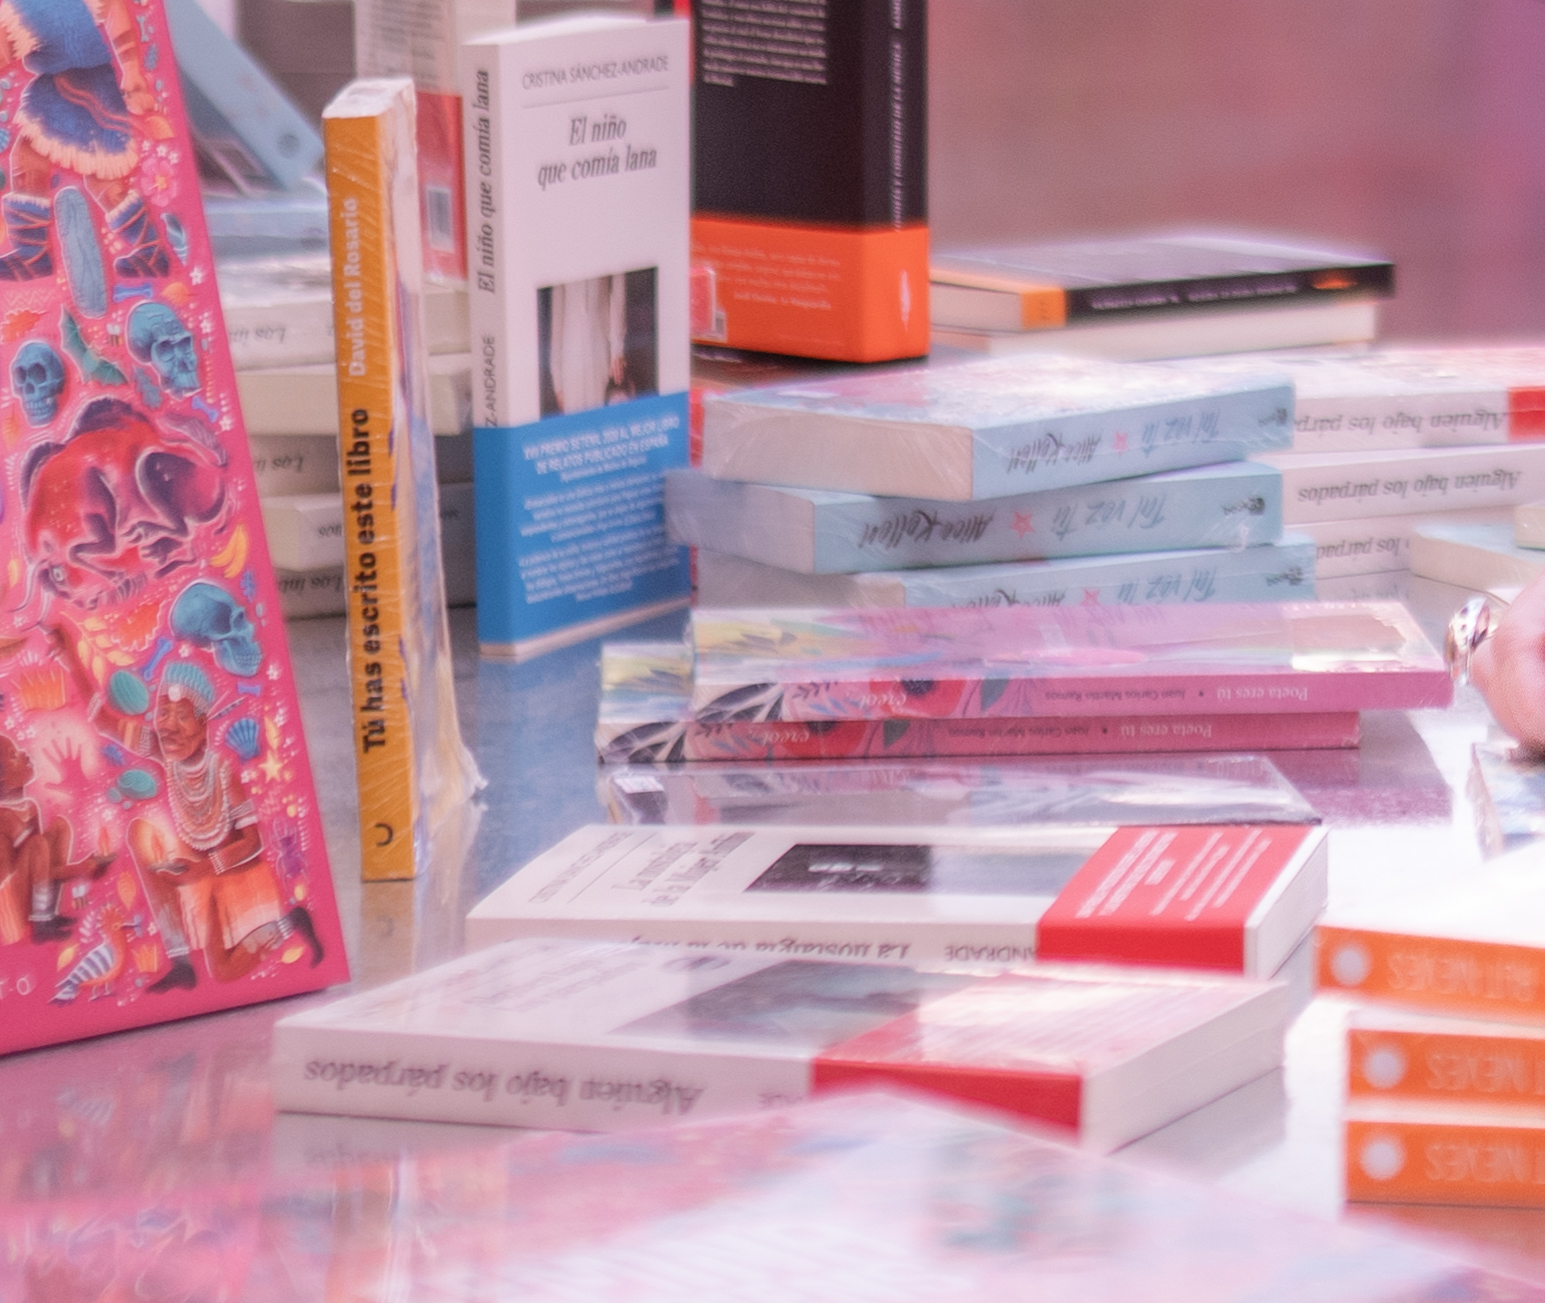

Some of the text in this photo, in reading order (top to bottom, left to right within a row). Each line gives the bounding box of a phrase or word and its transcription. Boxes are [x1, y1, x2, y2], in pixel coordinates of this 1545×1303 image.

[522, 54, 669, 90] CRISTINA SÁNCHEZ-ANDRADE
[569, 113, 627, 146] El niño
[472, 69, 497, 295] El niño que comía lana
[537, 143, 657, 192] que comía lana
[340, 197, 367, 377] David del Rosario
[1348, 414, 1376, 433] los
[1384, 412, 1422, 434] bajo
[1431, 410, 1509, 432] Alguien
[1005, 431, 1101, 475] Alice Kellen
[1297, 468, 1523, 507] Alguien bajo los párpados
[859, 508, 996, 550] Alice Kellen
[1378, 539, 1401, 557] los
[347, 407, 386, 755] Tú has escrito este libro
[1217, 687, 1309, 702] Poeta eres tú
[1120, 724, 1213, 739] Poeta eres tú
[303, 1059, 705, 1116] Alguien bajo los párpados
